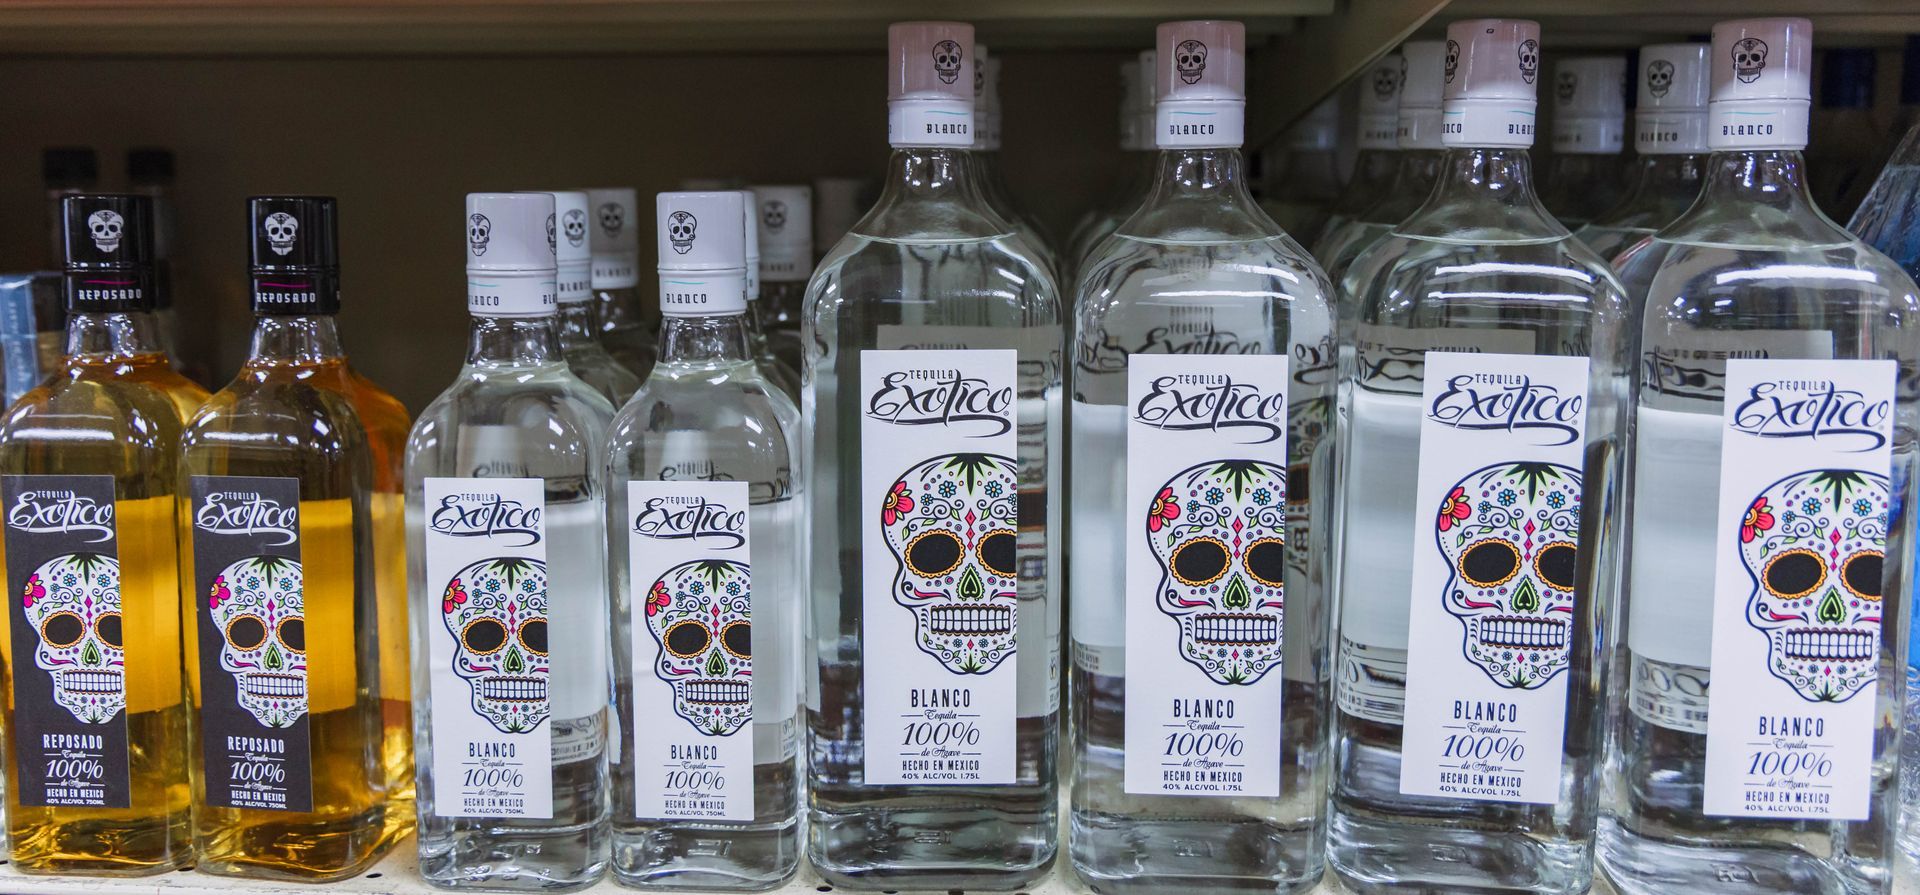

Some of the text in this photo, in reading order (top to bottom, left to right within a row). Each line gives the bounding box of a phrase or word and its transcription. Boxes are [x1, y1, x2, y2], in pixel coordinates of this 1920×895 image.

[926, 123, 967, 134] BLANCO
[1169, 124, 1214, 135] BLANCO
[1722, 125, 1773, 135] BLANCO
[79, 289, 142, 300] REPOSADO
[256, 292, 316, 303] REPOSADO
[666, 293, 707, 304] BLANCO
[909, 370, 953, 380] TEQUILA
[1178, 375, 1223, 385] TEQUILA
[1475, 373, 1521, 385] TEQUILA
[1778, 380, 1826, 391] TEQUILA
[37, 490, 69, 499] TEQUILA
[223, 491, 254, 500] TEQUILA
[461, 493, 494, 501] TEQUILA
[665, 496, 700, 504] TEQUILA
[911, 689, 970, 708] BLANCO
[1174, 699, 1233, 718] BLANCO
[1454, 700, 1517, 722] BLANCO
[924, 709, 957, 721] Tequila
[1186, 719, 1220, 732] Tequila
[1467, 722, 1501, 735] Tequila
[1759, 716, 1823, 737] BLANCO
[902, 721, 980, 746] 100%
[43, 734, 103, 749] REPOSADO
[227, 736, 284, 753] REPOSADO
[1163, 732, 1243, 757] 100%
[1772, 737, 1808, 750] Tequila
[469, 742, 515, 757] BLANCO
[671, 744, 717, 760] BLANCO
[921, 746, 961, 758] de Agave
[1441, 735, 1524, 761] 100%
[46, 759, 104, 779] 100%
[902, 760, 979, 770] HECHO EN MEXICO
[1183, 757, 1223, 769] de Agave
[1460, 760, 1502, 773] de Agave
[1749, 751, 1832, 777] 100%
[230, 762, 285, 783] 100%
[464, 768, 523, 788] 100%
[1163, 770, 1242, 782] HECHO EN MEXICO
[665, 771, 725, 790] 100%
[1440, 772, 1522, 788] HECHO EN MEXICO
[1766, 778, 1810, 790] de Agave
[46, 788, 104, 798] HECHO EN MEXICO
[231, 790, 286, 802] HECHO EN MEXICO
[1461, 787, 1497, 795] ALC/VOL
[1501, 789, 1521, 797] 1.75L
[1746, 791, 1830, 804] HECHO EN MEXICO
[464, 798, 524, 808] HECHO EN MEXICO
[665, 800, 725, 810] HECHO EN MEXICO
